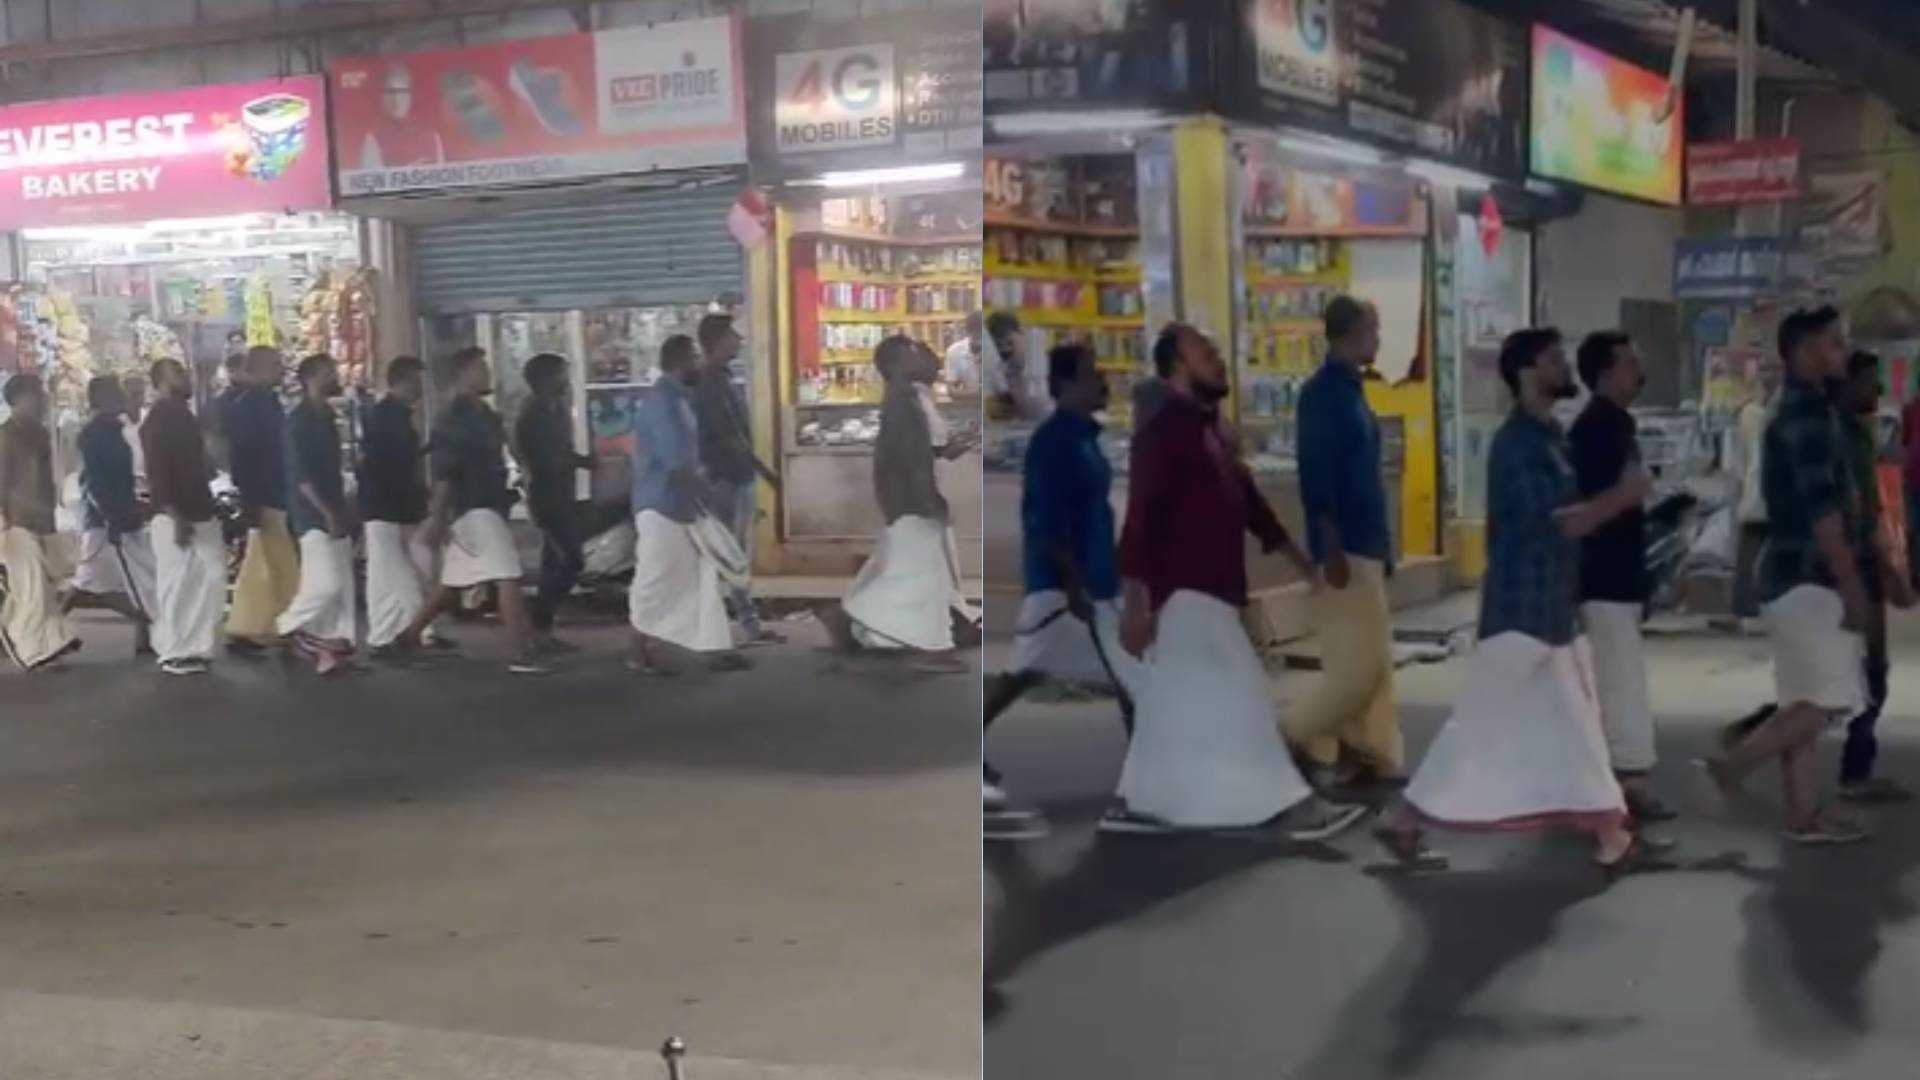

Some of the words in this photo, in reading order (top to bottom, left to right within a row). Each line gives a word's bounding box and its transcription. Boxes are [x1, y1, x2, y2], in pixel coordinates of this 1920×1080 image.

[660, 69, 720, 100] PRIDE
[787, 53, 882, 111] 4G
[0, 112, 195, 164] EVEREST
[781, 117, 891, 144] MOBILES
[21, 166, 162, 200] BAKERY
[349, 173, 386, 190] NEW
[390, 165, 464, 187] FASHION
